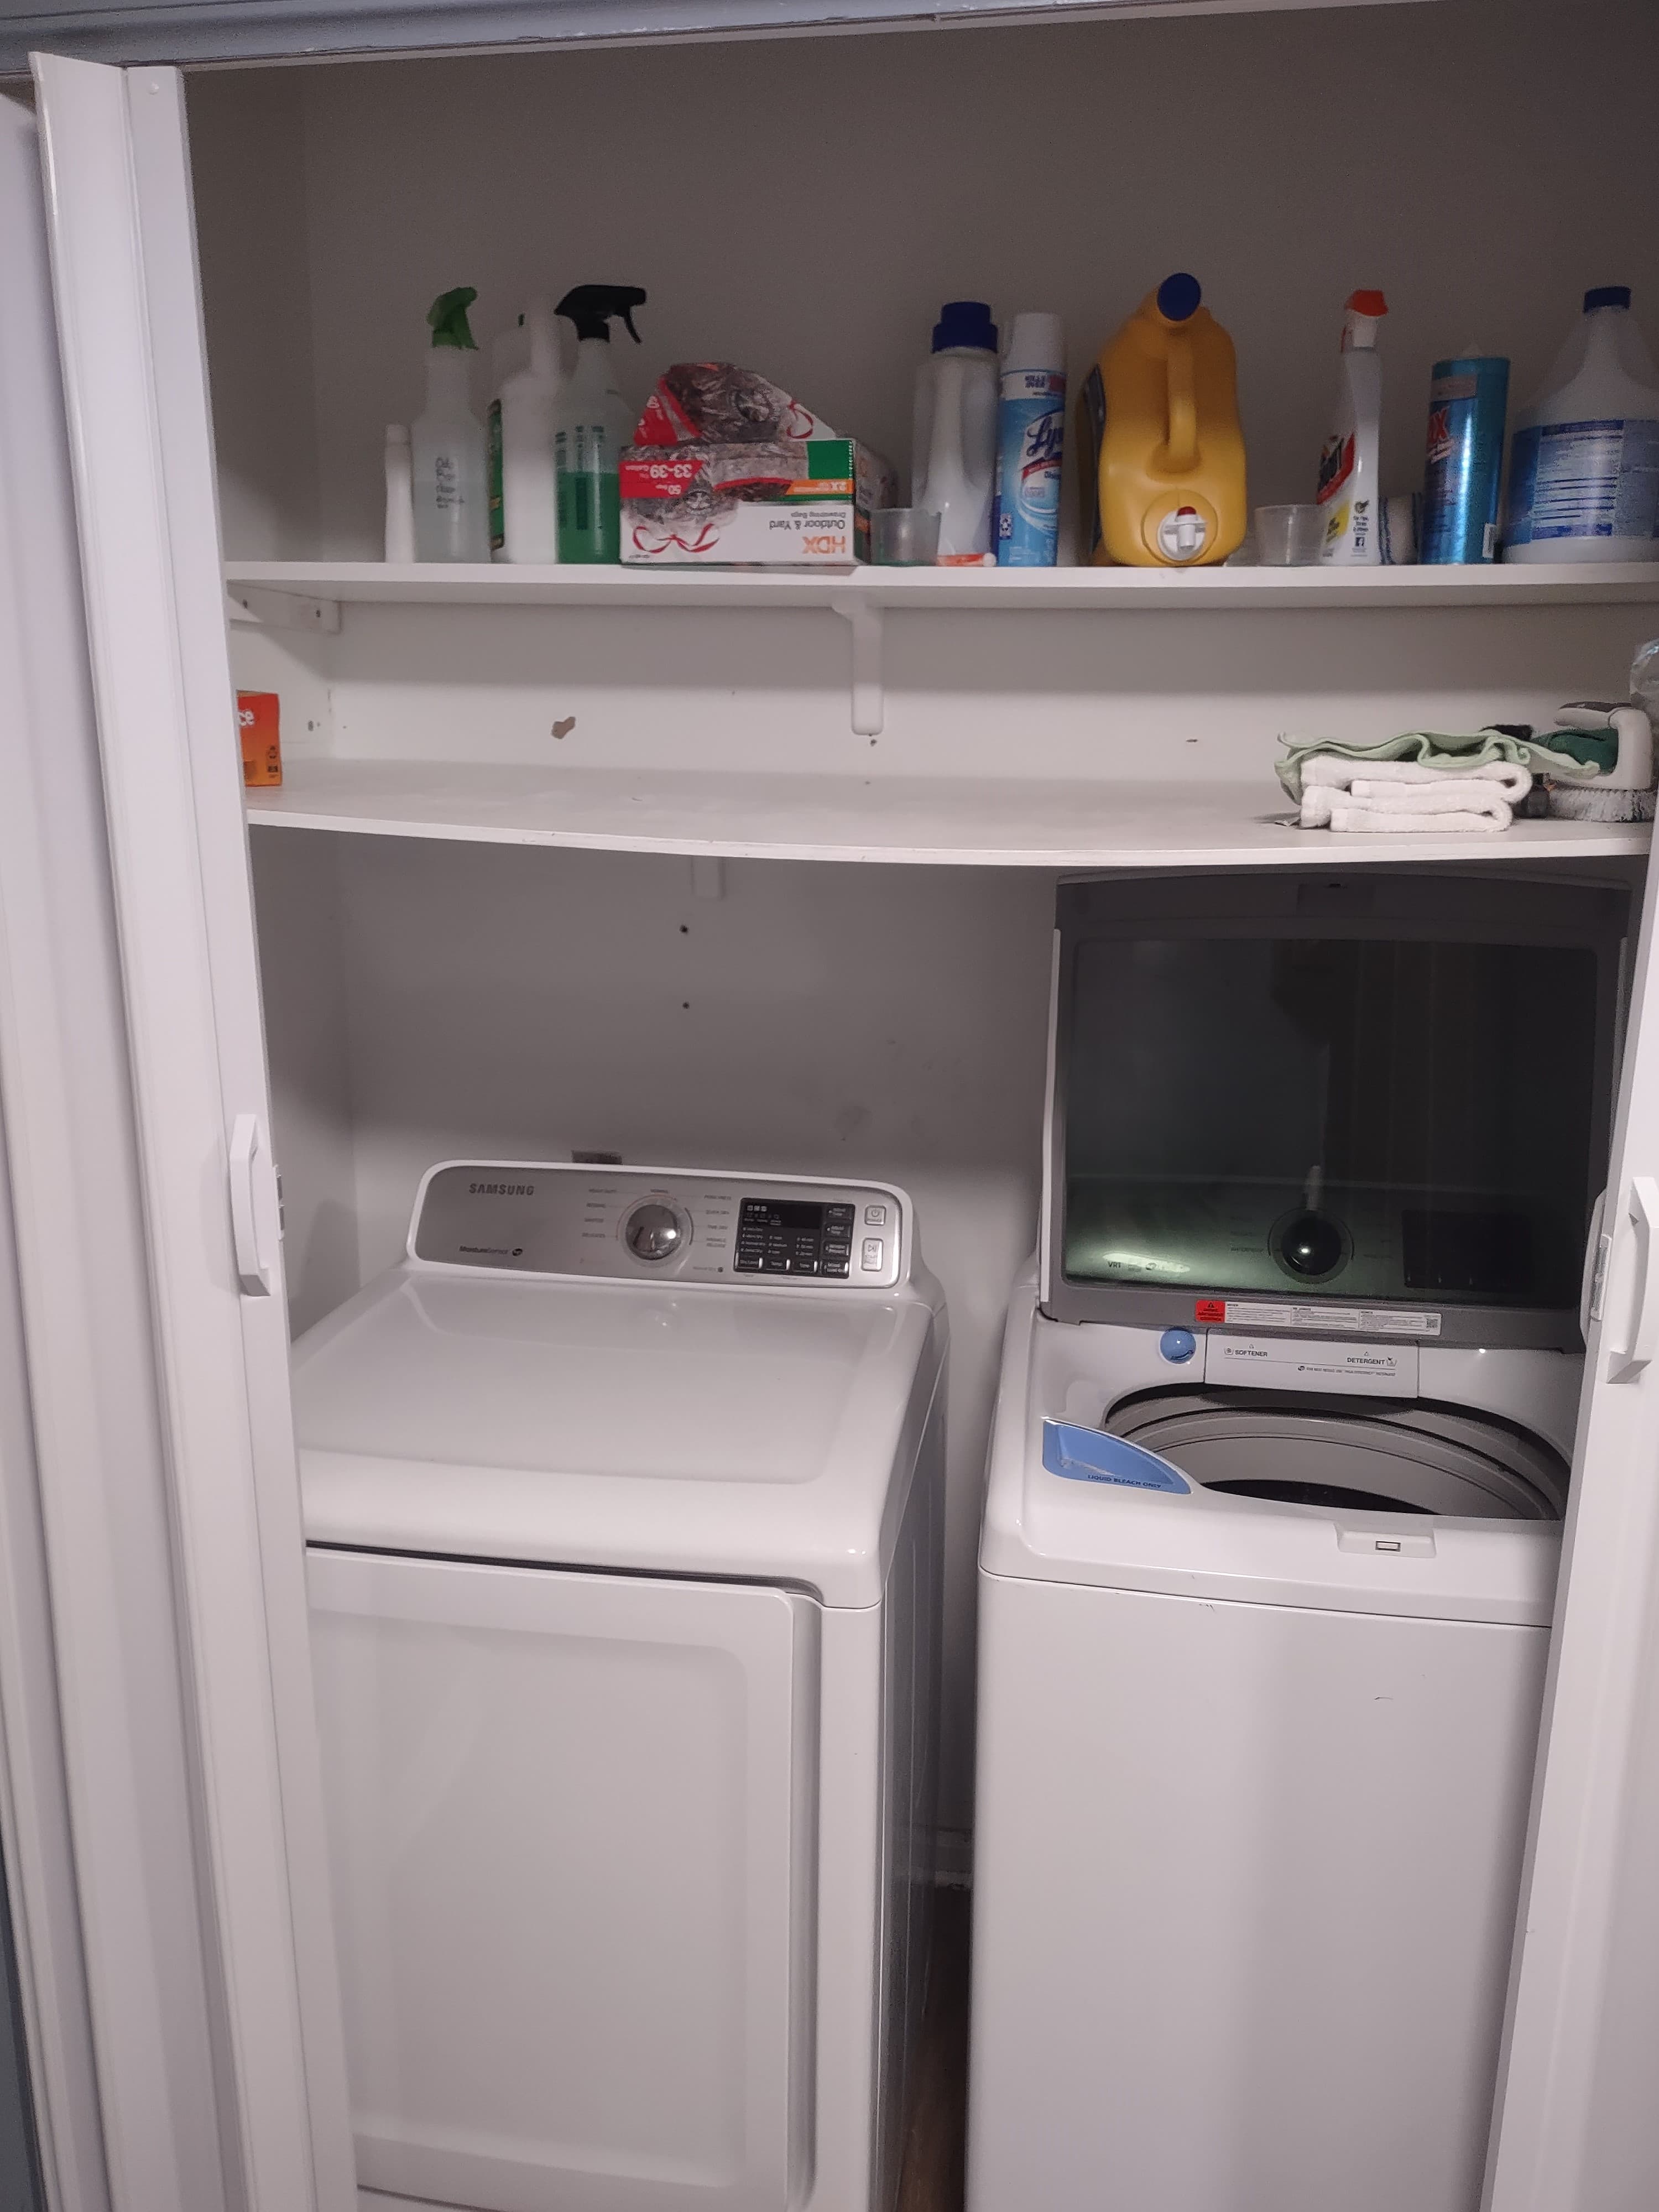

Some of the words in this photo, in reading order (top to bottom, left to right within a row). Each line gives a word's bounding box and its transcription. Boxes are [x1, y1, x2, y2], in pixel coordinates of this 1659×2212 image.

[649, 463, 692, 479] 33-39
[769, 520, 792, 530] Yard
[794, 520, 802, 530] &
[805, 520, 846, 530] Outdoor
[802, 536, 846, 554] HDX
[469, 1183, 535, 1196] SAMSUNG
[1347, 1357, 1385, 1365] DETERGENT
[1114, 1478, 1141, 1486] BLEACH
